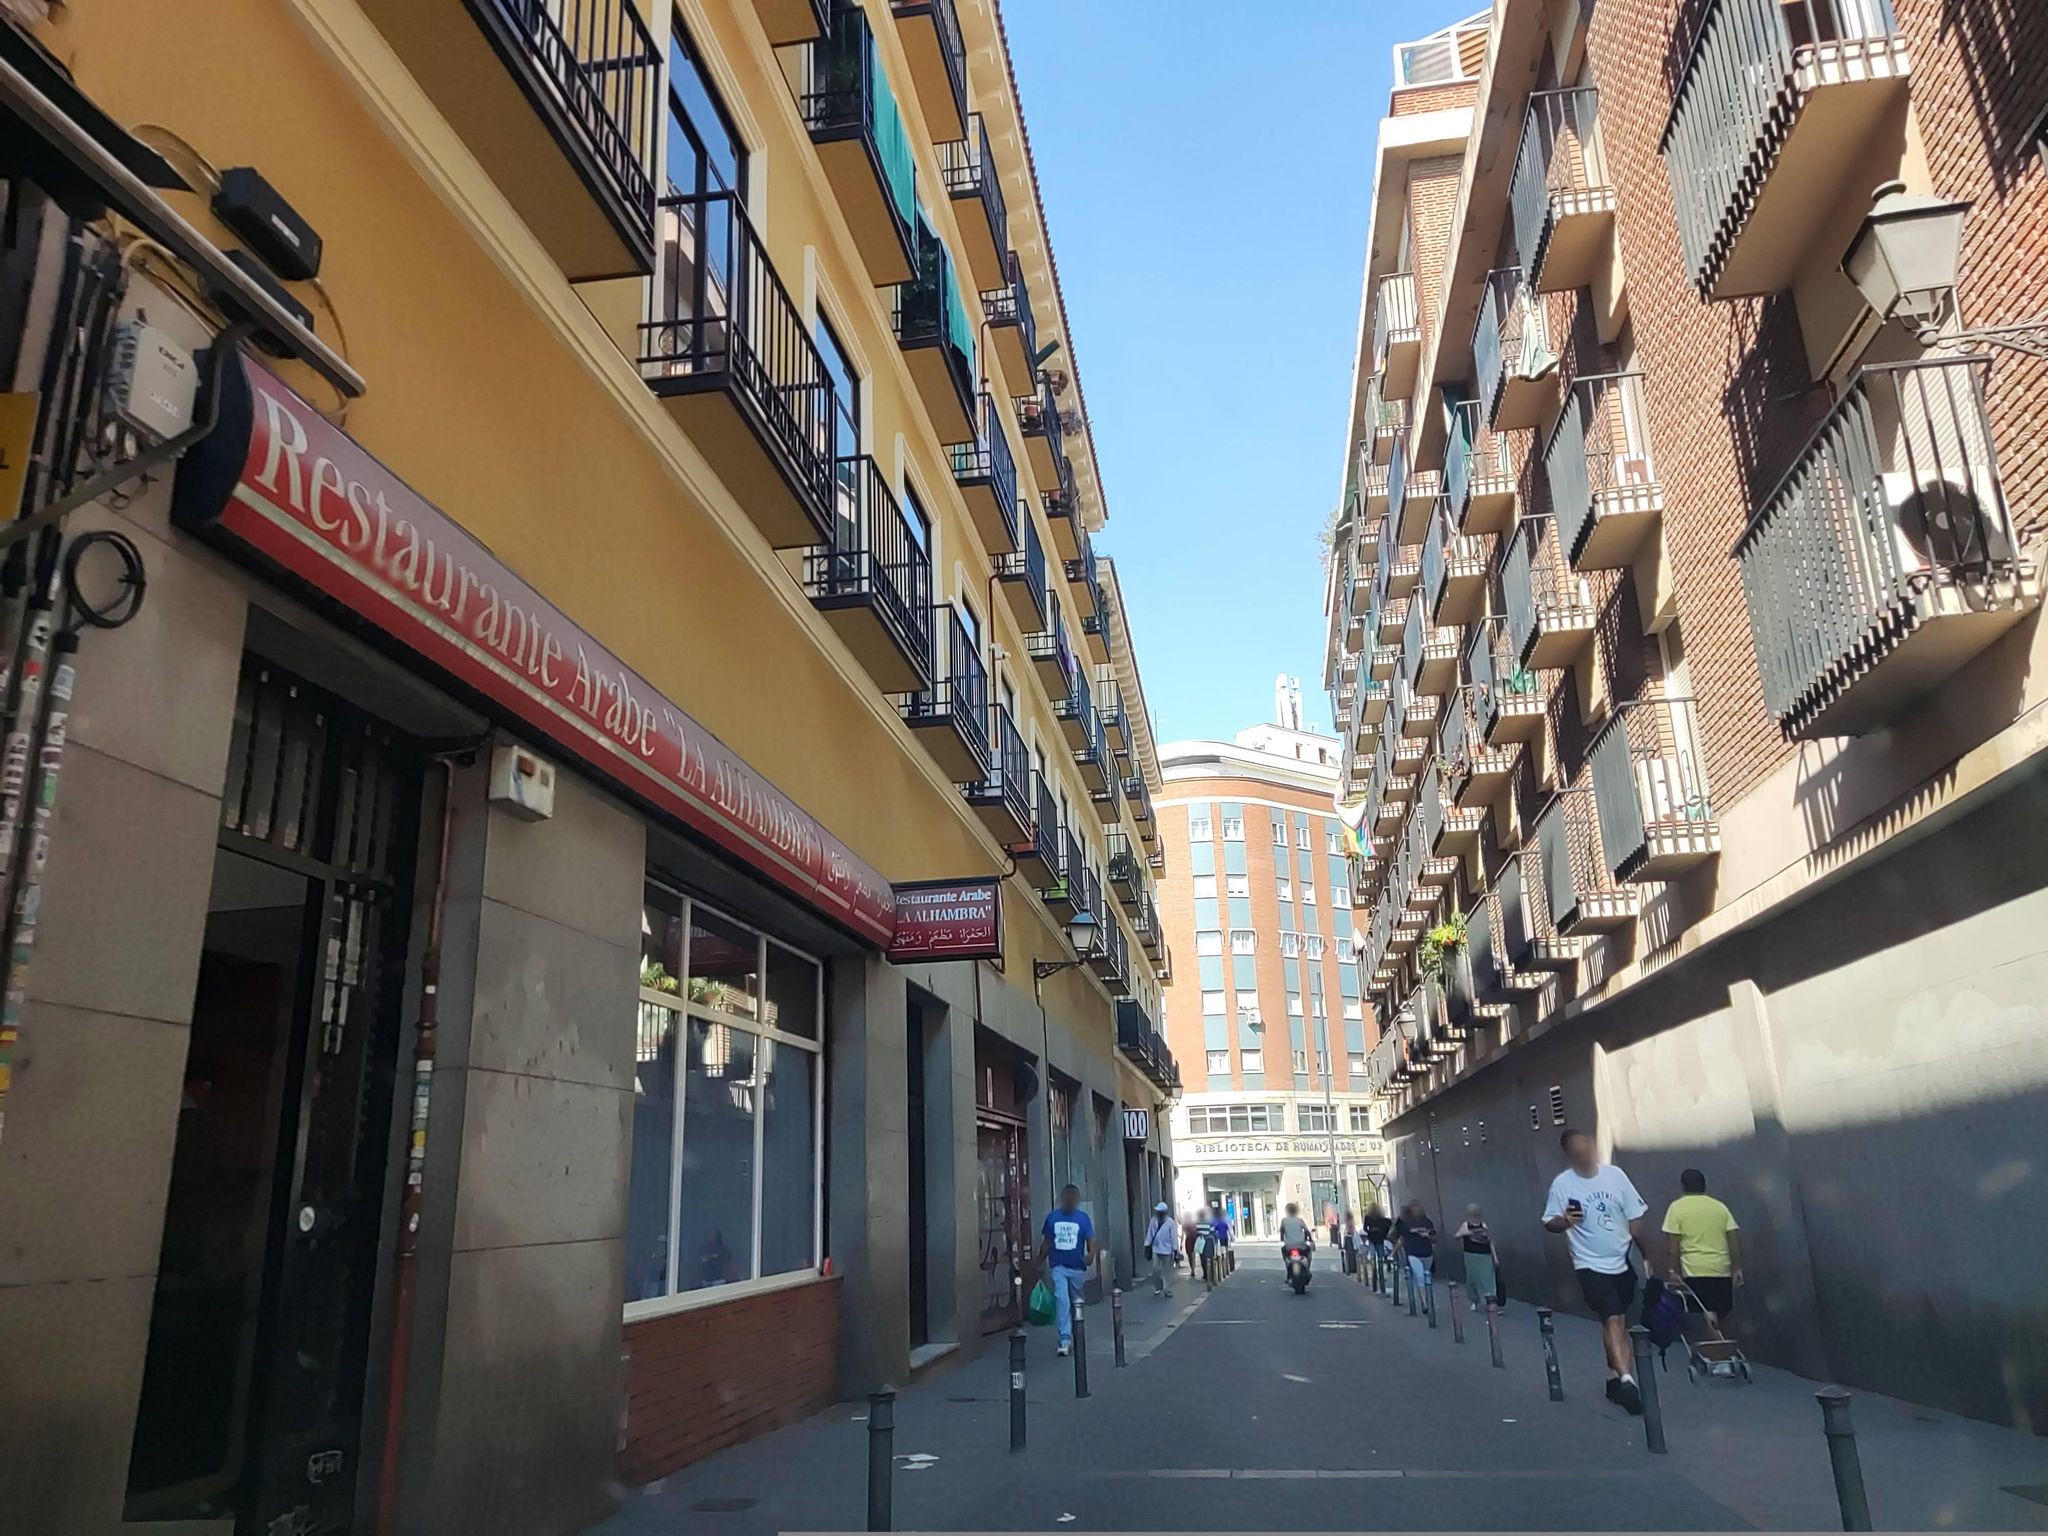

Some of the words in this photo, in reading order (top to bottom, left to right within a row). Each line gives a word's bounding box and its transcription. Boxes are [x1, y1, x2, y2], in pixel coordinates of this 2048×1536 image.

[254, 386, 563, 687] Restaurante
[568, 642, 657, 757] Arabe
[663, 707, 706, 793] "LA
[710, 759, 815, 867] ALHAMBRA"
[958, 888, 992, 902] Arabe
[913, 905, 992, 923] ALHAMBRA"
[1123, 1112, 1146, 1137] 100
[1195, 1142, 1270, 1154] BIBLIOTECA
[1275, 1142, 1290, 1152] DE
